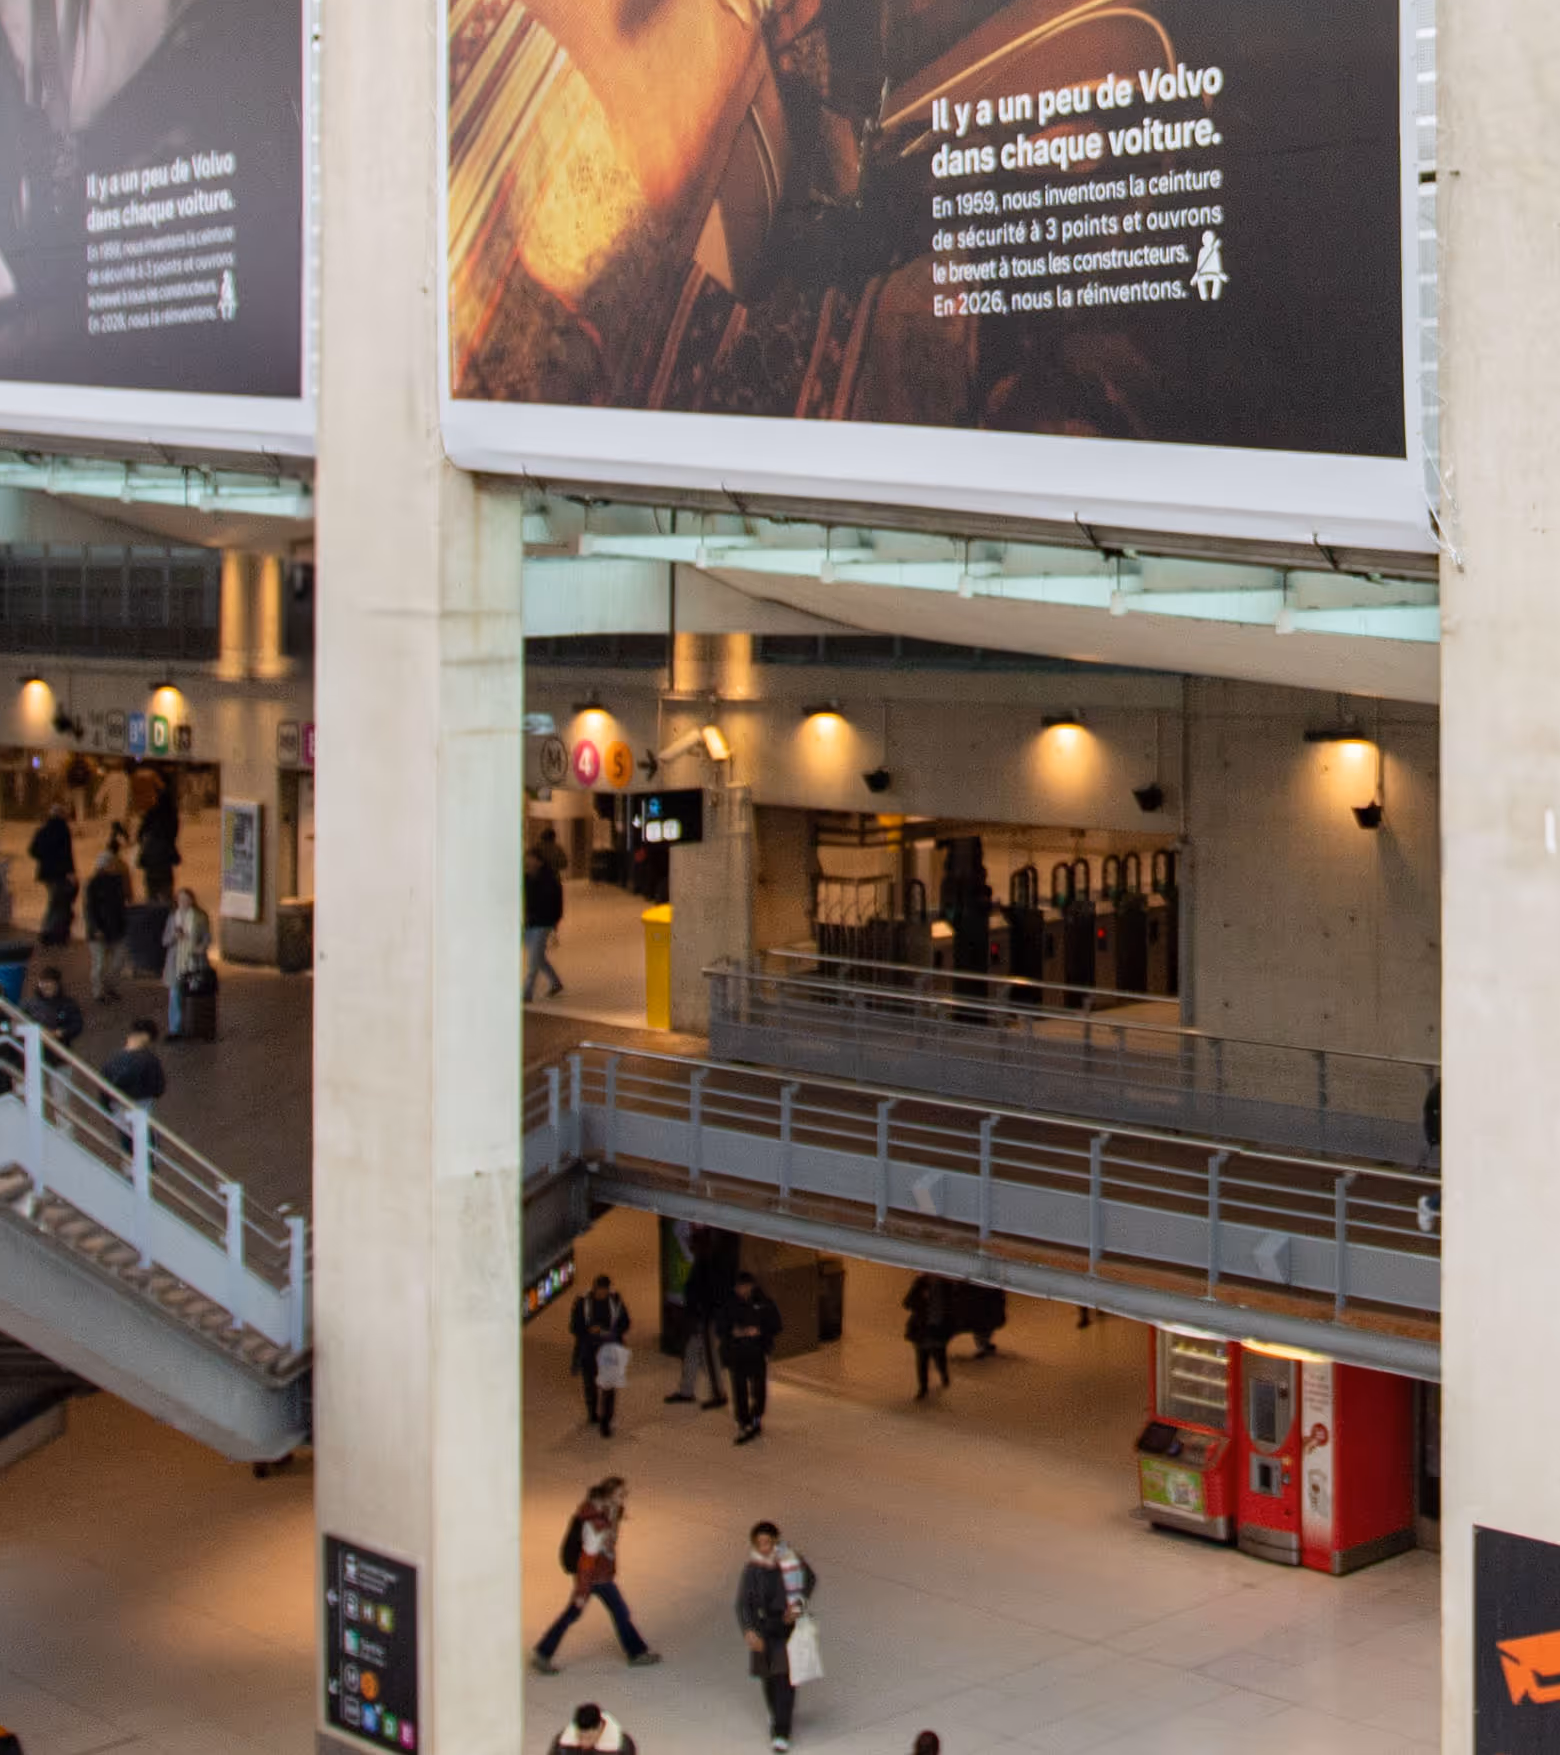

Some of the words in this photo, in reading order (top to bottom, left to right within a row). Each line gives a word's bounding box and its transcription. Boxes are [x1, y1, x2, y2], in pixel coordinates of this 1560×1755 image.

[933, 97, 949, 131] Il
[954, 103, 970, 136] y
[976, 100, 993, 125] a
[999, 93, 1032, 123] un
[1038, 86, 1092, 125] peu
[1096, 73, 1133, 109] de
[1139, 63, 1222, 102] Volvo
[932, 144, 995, 177] dans
[1001, 133, 1103, 171] chaque
[1108, 118, 1221, 156] voiture.
[86, 175, 96, 199] Il
[98, 175, 107, 204] y
[109, 179, 119, 195] a
[121, 173, 138, 191] un
[141, 166, 169, 195] peu
[170, 157, 189, 183] de
[191, 151, 235, 177] Volvo
[933, 196, 951, 218] En
[956, 191, 998, 214] 1959,
[1003, 191, 1041, 209] nous
[1045, 181, 1126, 205] inventons
[1130, 175, 1144, 196] la
[1149, 170, 1221, 194] ceinture
[87, 210, 120, 232] dans
[122, 199, 175, 229] chaque
[177, 188, 235, 217] voiture.
[933, 230, 953, 250] de
[958, 222, 1025, 248] sécurité
[1031, 220, 1040, 241] à
[1046, 218, 1056, 240] 3
[1062, 215, 1118, 243] points
[1123, 212, 1141, 232] et
[1147, 206, 1222, 230] ouvrons
[933, 263, 947, 284] le
[949, 261, 996, 282] brevet
[999, 257, 1008, 278] à
[1012, 258, 1046, 276] tous
[1049, 252, 1070, 273] les
[1073, 245, 1188, 271] constructeurs.
[934, 295, 955, 316] En
[958, 291, 1006, 314] 2026,
[1012, 292, 1052, 309] nous
[1057, 286, 1072, 307] la
[1078, 281, 1185, 305] réinventons.
[578, 746, 593, 777] 4
